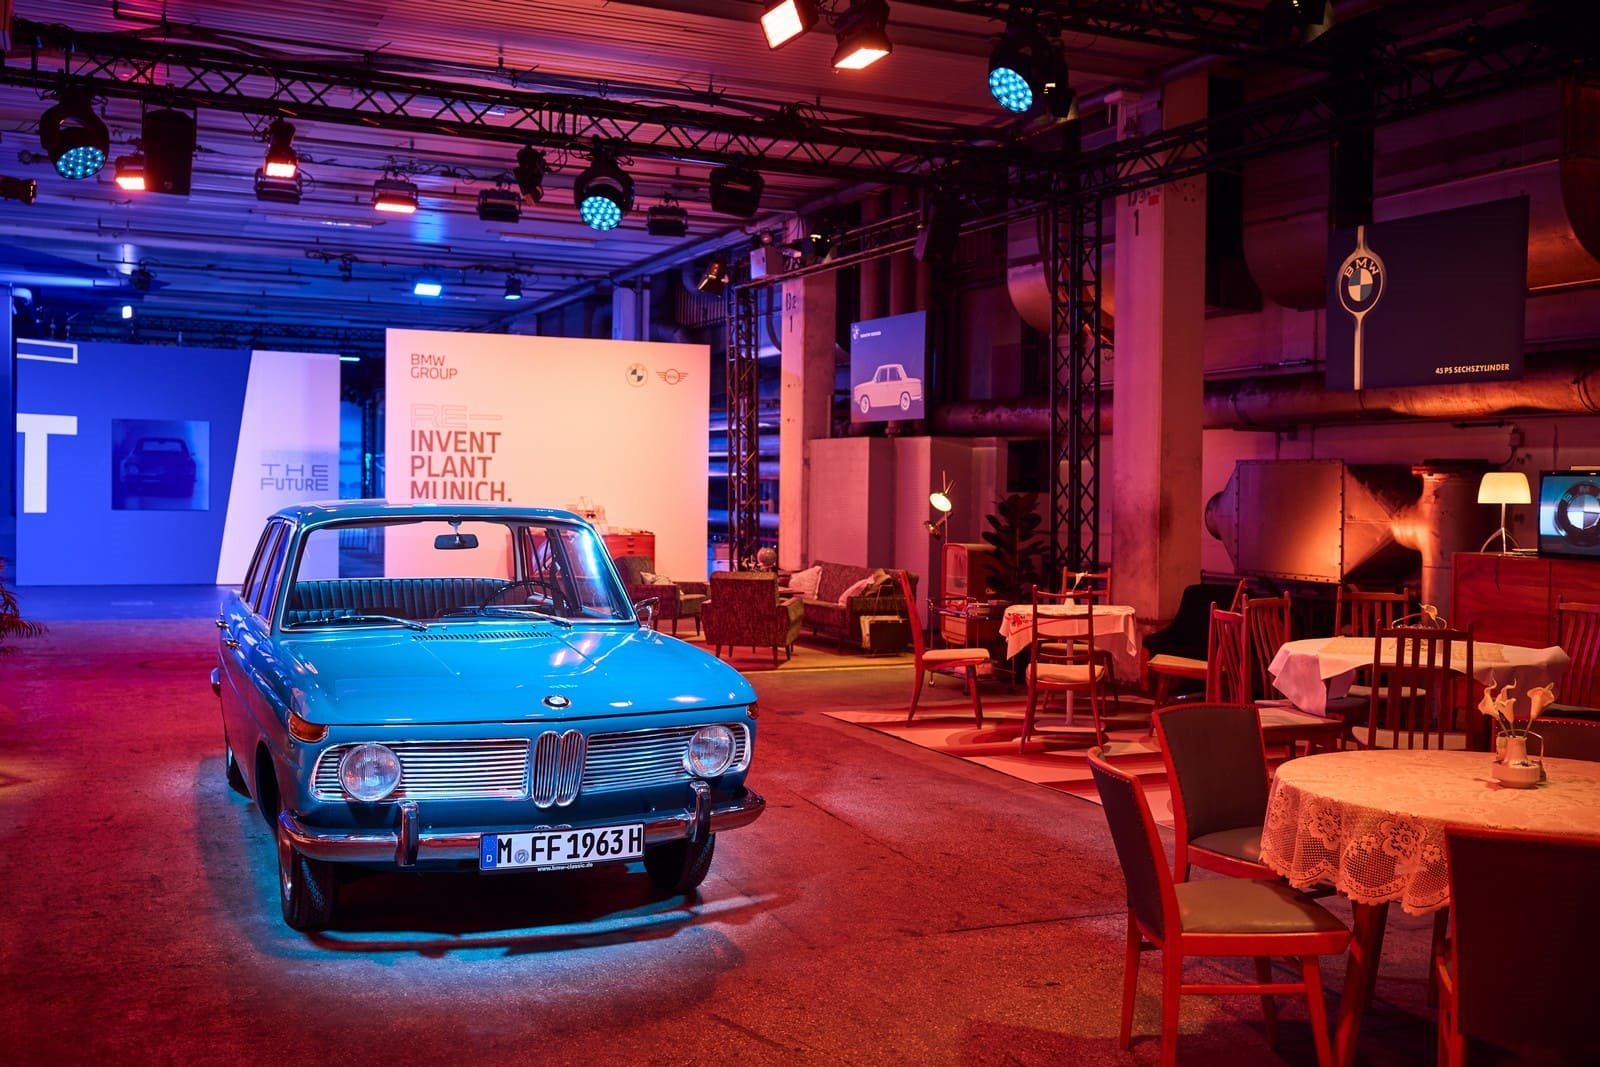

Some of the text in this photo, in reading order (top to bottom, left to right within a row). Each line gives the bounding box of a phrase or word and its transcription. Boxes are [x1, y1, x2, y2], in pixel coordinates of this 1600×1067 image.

[1344, 258, 1379, 278] BMW
[410, 353, 445, 366] BMW
[410, 366, 458, 380] GROUP
[1435, 363, 1510, 375] 45 PS SECHSZYLINDER
[410, 429, 502, 453] INVENT
[260, 463, 329, 478] THE
[410, 455, 493, 478] PLANT
[260, 477, 329, 492] FUTURE
[410, 480, 512, 502] MUNICH.
[486, 854, 493, 863] D
[497, 838, 512, 864] M
